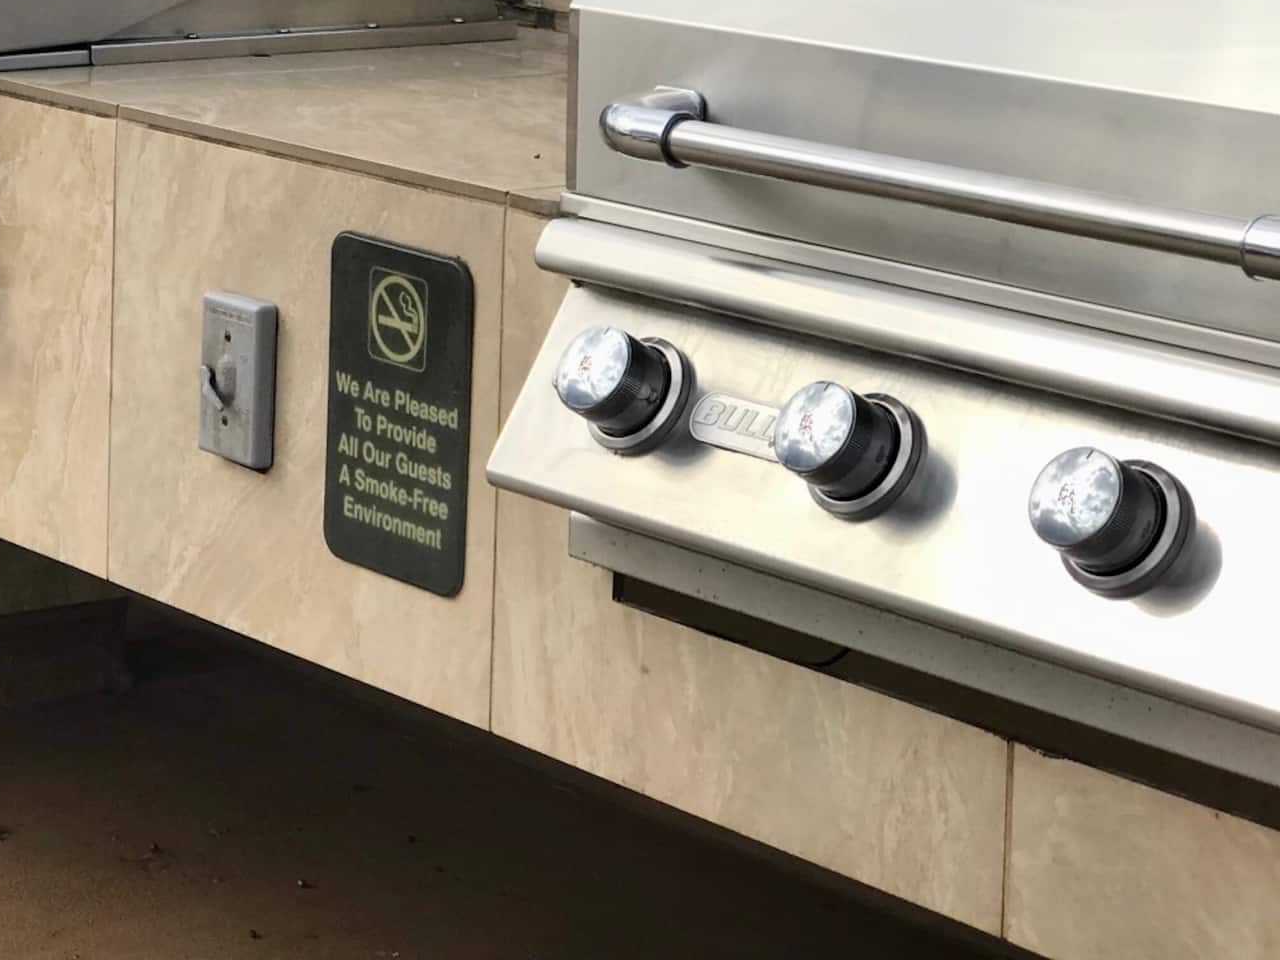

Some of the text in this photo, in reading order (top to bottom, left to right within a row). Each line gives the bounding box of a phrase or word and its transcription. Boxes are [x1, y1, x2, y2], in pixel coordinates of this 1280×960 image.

[336, 370, 459, 430] We Are Pleased
[354, 406, 438, 454] To Provide
[338, 432, 453, 491] All Our Guests
[339, 463, 449, 520] A Smoke-Free
[343, 494, 443, 550] Environment
